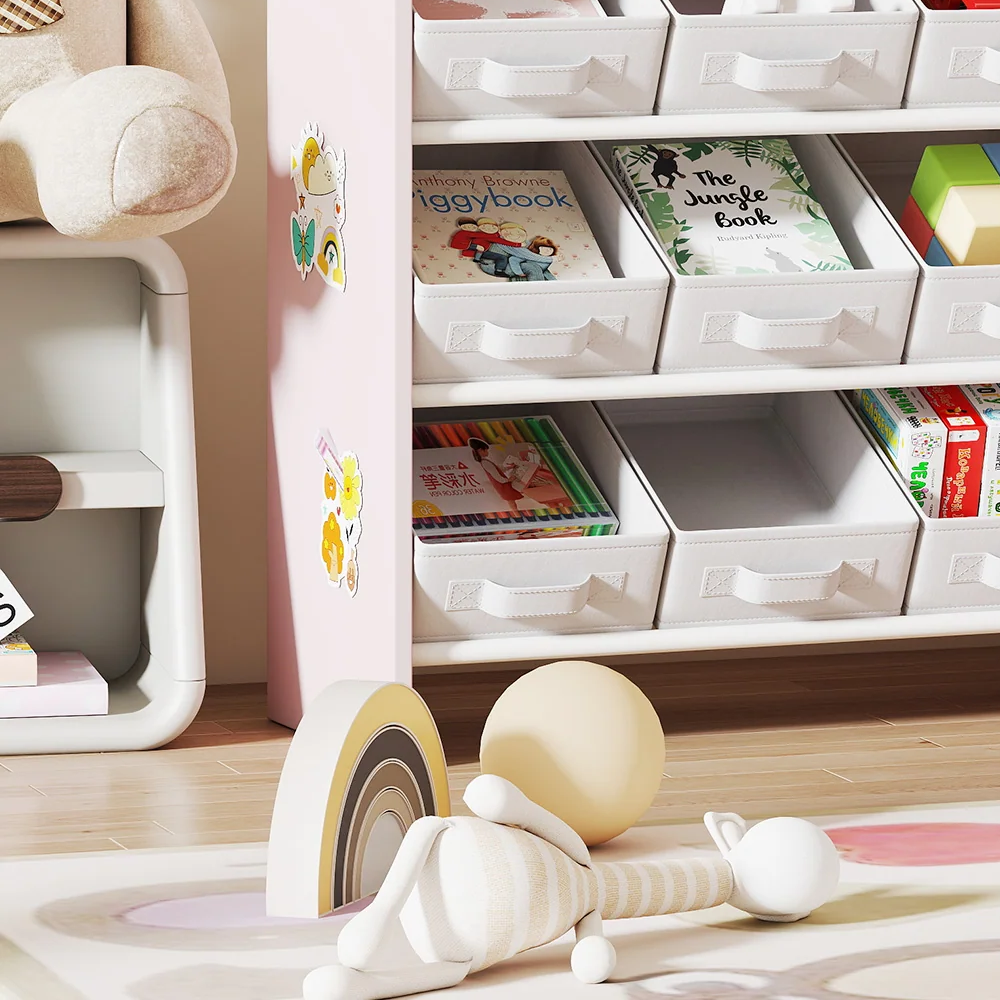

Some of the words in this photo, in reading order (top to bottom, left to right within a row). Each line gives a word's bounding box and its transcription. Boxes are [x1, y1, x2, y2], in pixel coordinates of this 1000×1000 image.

[482, 175, 550, 187] Browne
[691, 169, 737, 187] The
[412, 186, 574, 213] iggybook
[683, 184, 769, 211] Jungle
[713, 207, 778, 229] Book
[716, 233, 754, 243] Rudyard
[755, 231, 789, 243] Kipling
